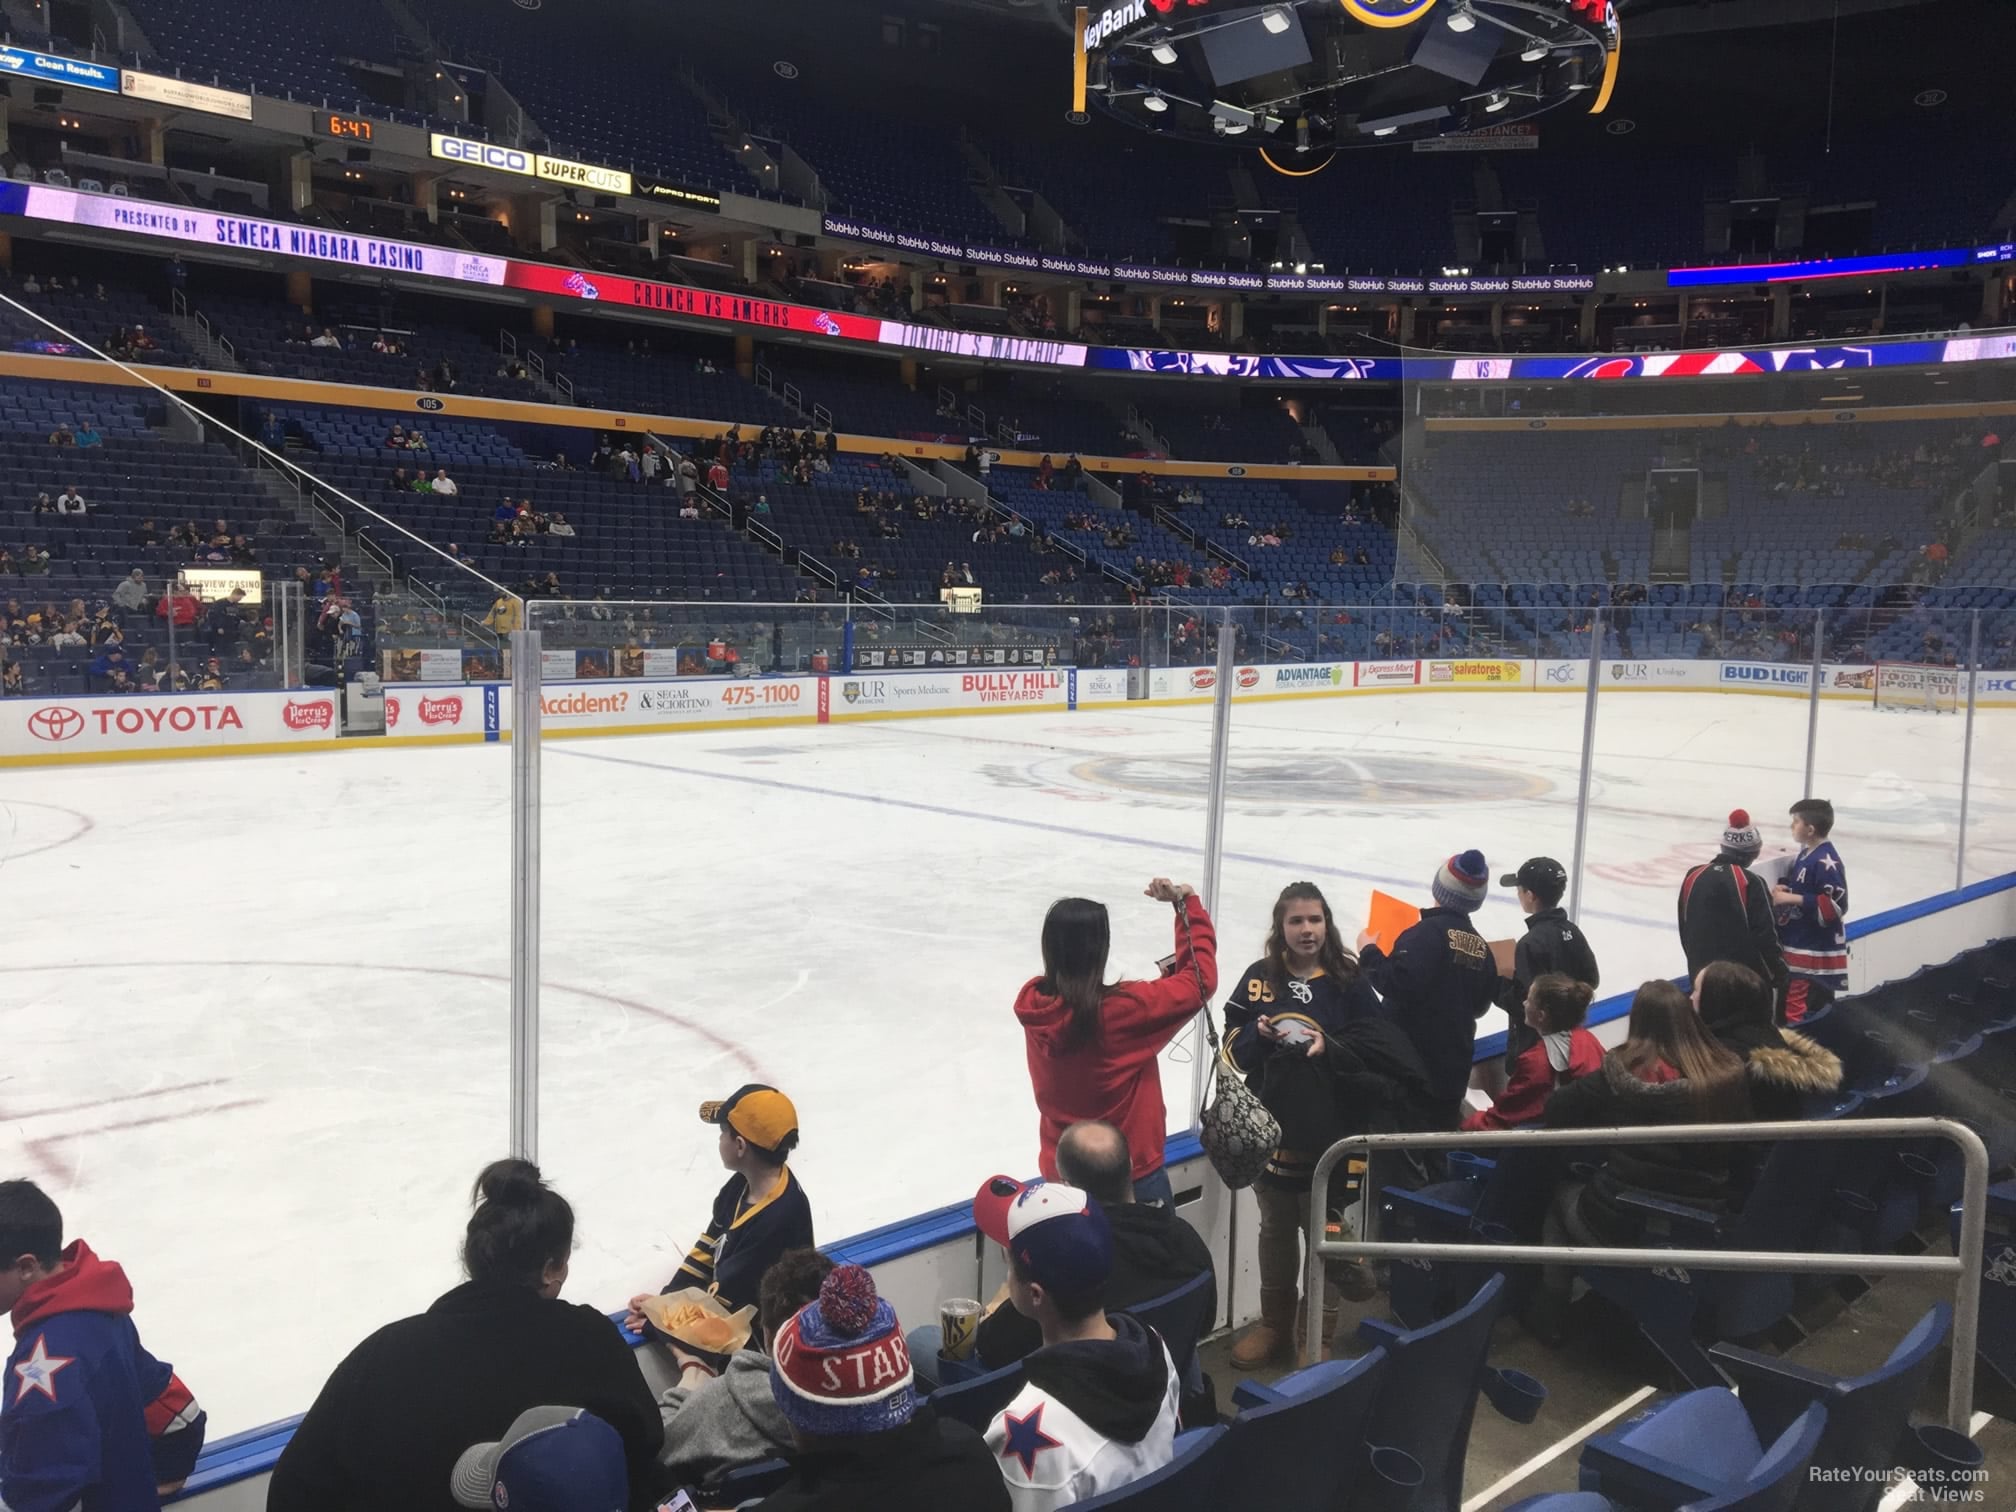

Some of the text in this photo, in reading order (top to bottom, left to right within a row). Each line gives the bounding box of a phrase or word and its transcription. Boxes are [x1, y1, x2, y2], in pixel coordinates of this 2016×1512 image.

[1084, 0, 1147, 53] KeyBank
[35, 56, 65, 72] Clean
[66, 63, 105, 79] Results.
[330, 116, 371, 139] 6:47
[441, 138, 526, 171] GEICO
[543, 161, 622, 189] SUPERCUTS
[685, 193, 720, 204] SPORTS
[115, 208, 423, 271] PRESENTED BY SENECA NIAGARA CASINO
[824, 219, 1593, 291] StubHub StubHub StubHub StubHub StubHub StubHub StubHub StubHub StubHub StubHub StubHub StubHub StubHub StubHub StubHub StubHub StubHub StubHub StubHub StubHub
[634, 283, 693, 311] CRUNCH
[705, 294, 721, 316] VS
[1477, 361, 1489, 377] VS
[423, 399, 437, 409] 105
[229, 580, 260, 589] CASINO
[1276, 667, 1332, 682] ADVANTAGE
[1368, 663, 1413, 674] Express Mart
[1455, 662, 1501, 675] salvatores
[1625, 664, 1647, 676] UR
[1725, 666, 1769, 680] BUD
[1772, 669, 1808, 683] LIGHT
[862, 680, 885, 698] UR
[962, 672, 1060, 692] BULLY HILL
[657, 689, 689, 699] SEGAR
[722, 684, 800, 705] 475-1100
[893, 684, 950, 698] Sports Medicine
[980, 690, 1044, 702] VINEYARDS
[640, 692, 652, 709] &
[657, 700, 709, 710] SCIORTINO
[289, 705, 328, 721] Perry's
[424, 701, 458, 717] Perry's
[488, 691, 497, 730] CCM
[92, 705, 243, 735] TOYOTA
[1797, 867, 1806, 883] A
